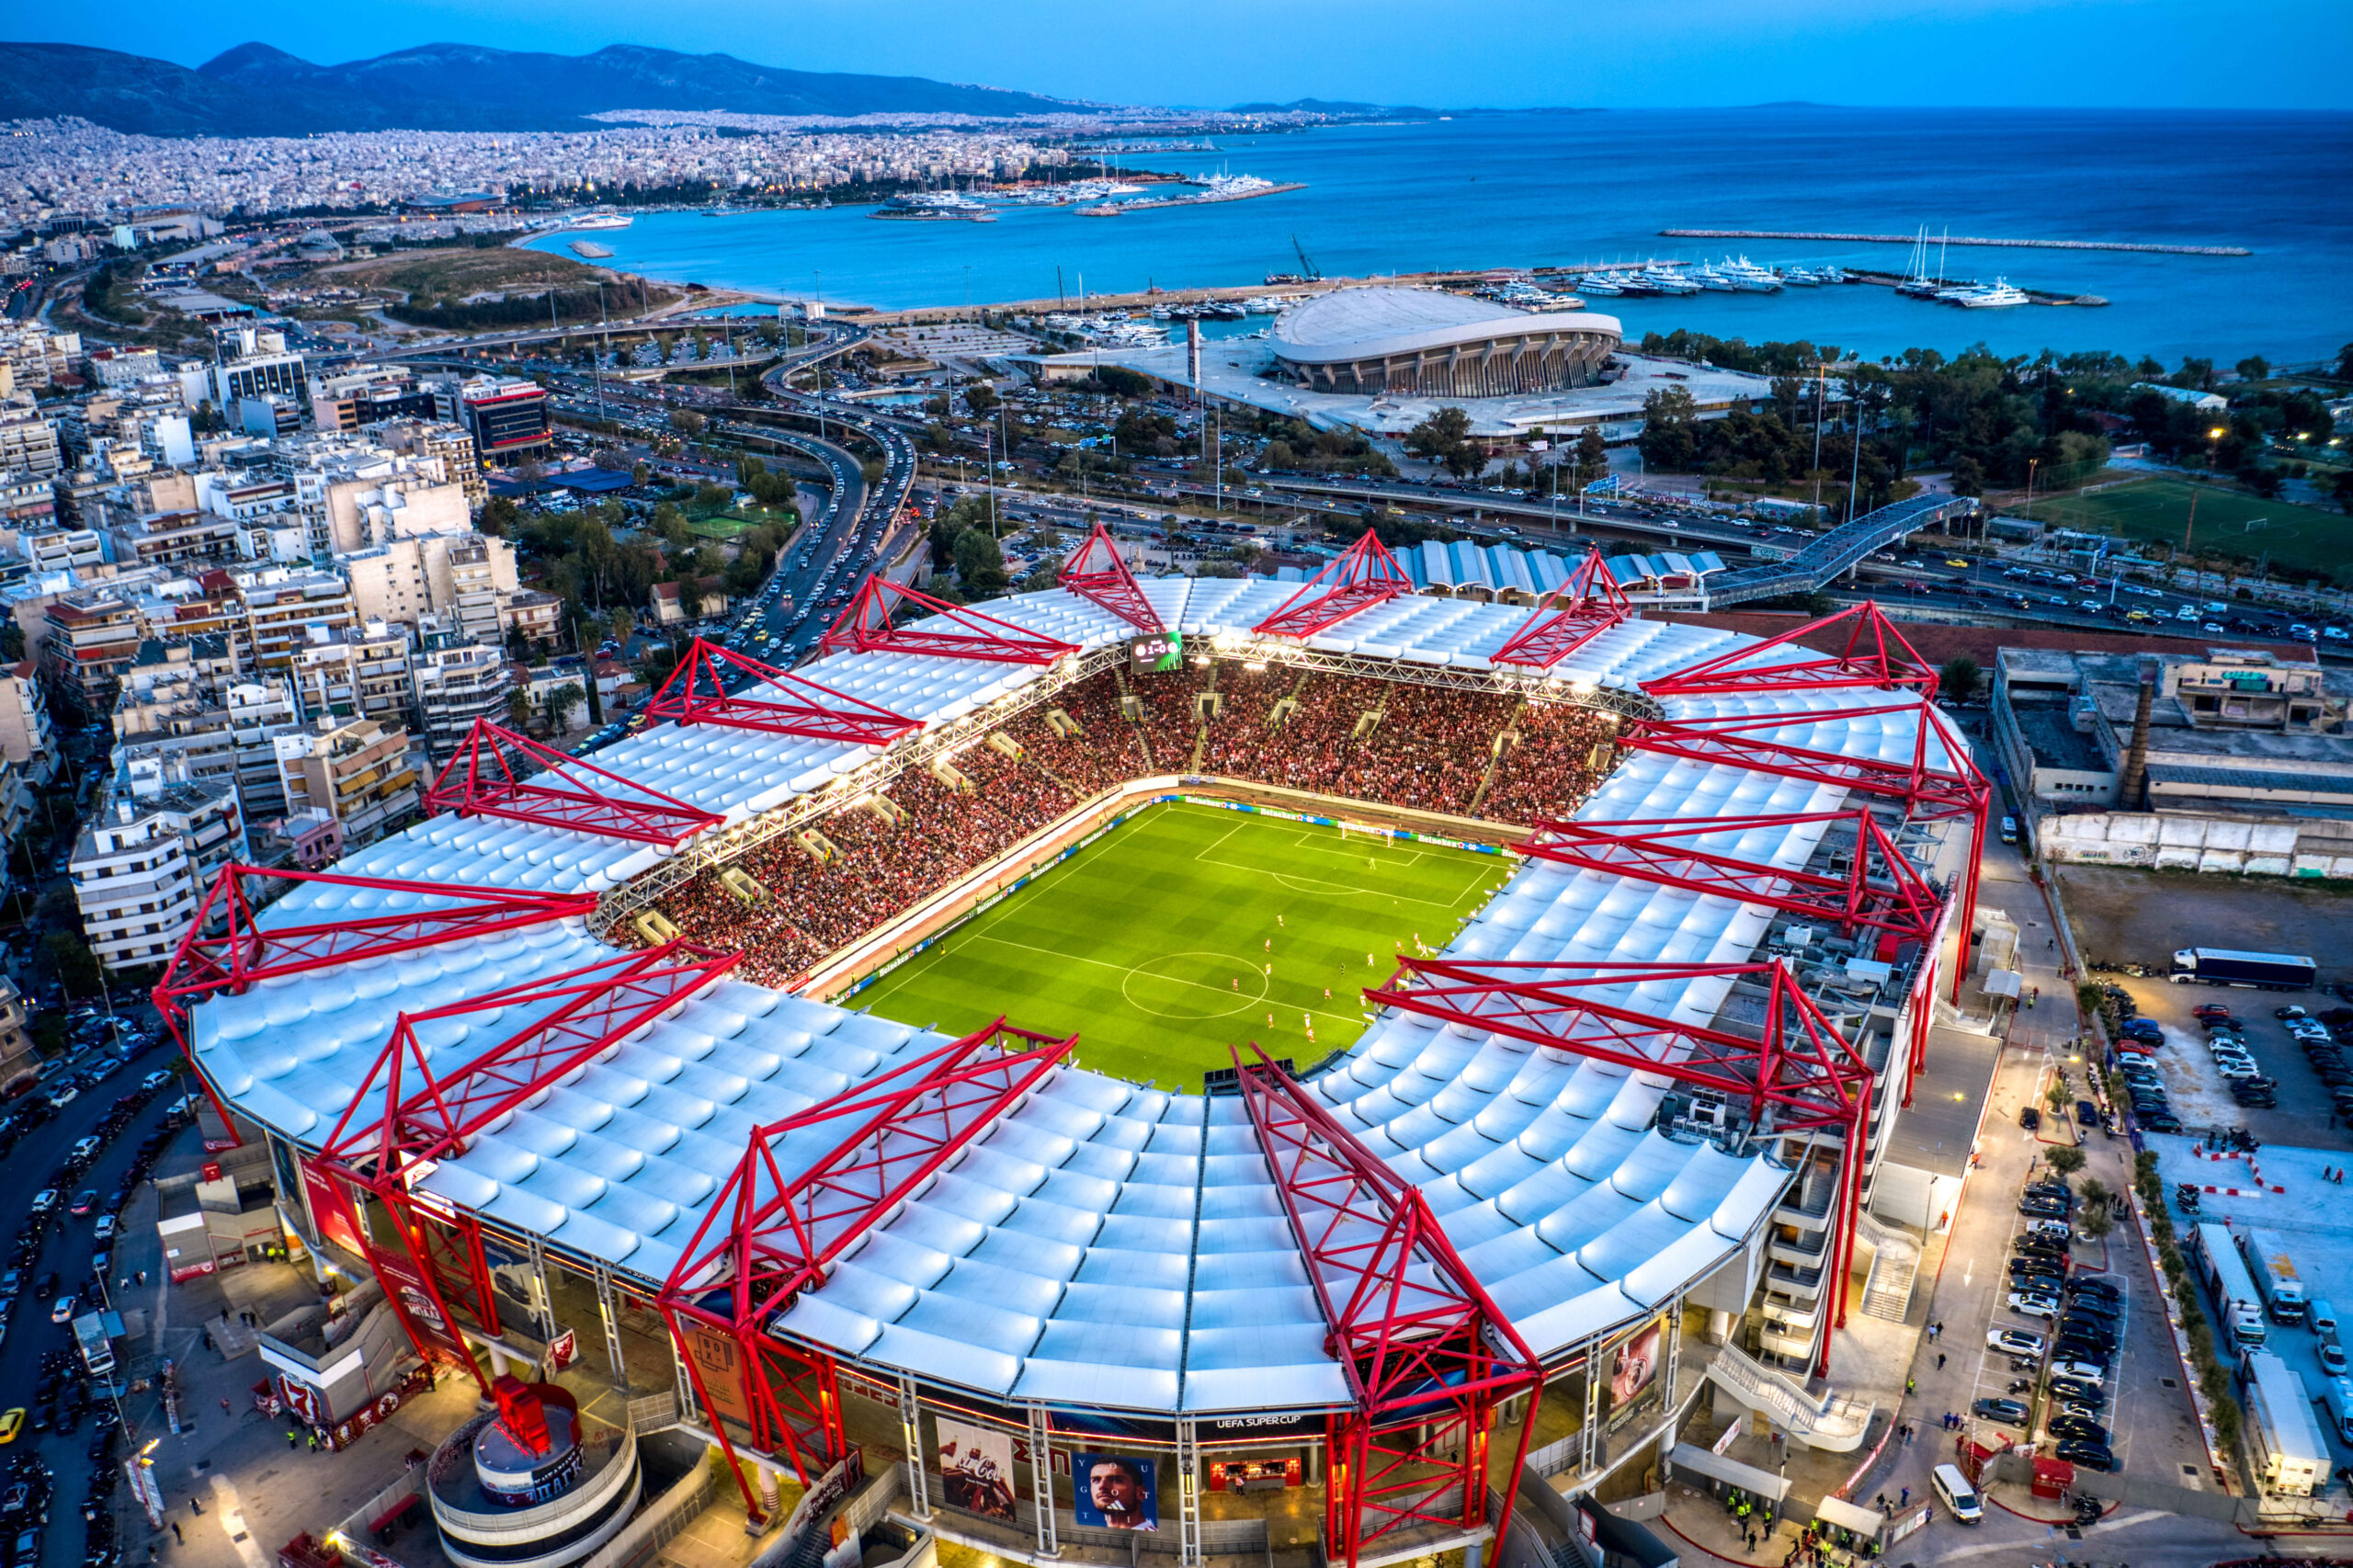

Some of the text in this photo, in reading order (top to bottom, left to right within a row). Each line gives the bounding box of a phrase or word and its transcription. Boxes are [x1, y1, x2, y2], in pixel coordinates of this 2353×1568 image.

[1186, 795, 1221, 808] Heineken
[1260, 808, 1297, 821] Heineken
[1417, 834, 1457, 848] Heineken
[1030, 860, 1055, 881] Heineken
[977, 893, 1004, 915] Heineken
[879, 954, 910, 978] Heineken
[1217, 1415, 1302, 1428] UEFA SUPER CUP
[1078, 1460, 1148, 1472] YOU
[1080, 1486, 1150, 1499] GOT
